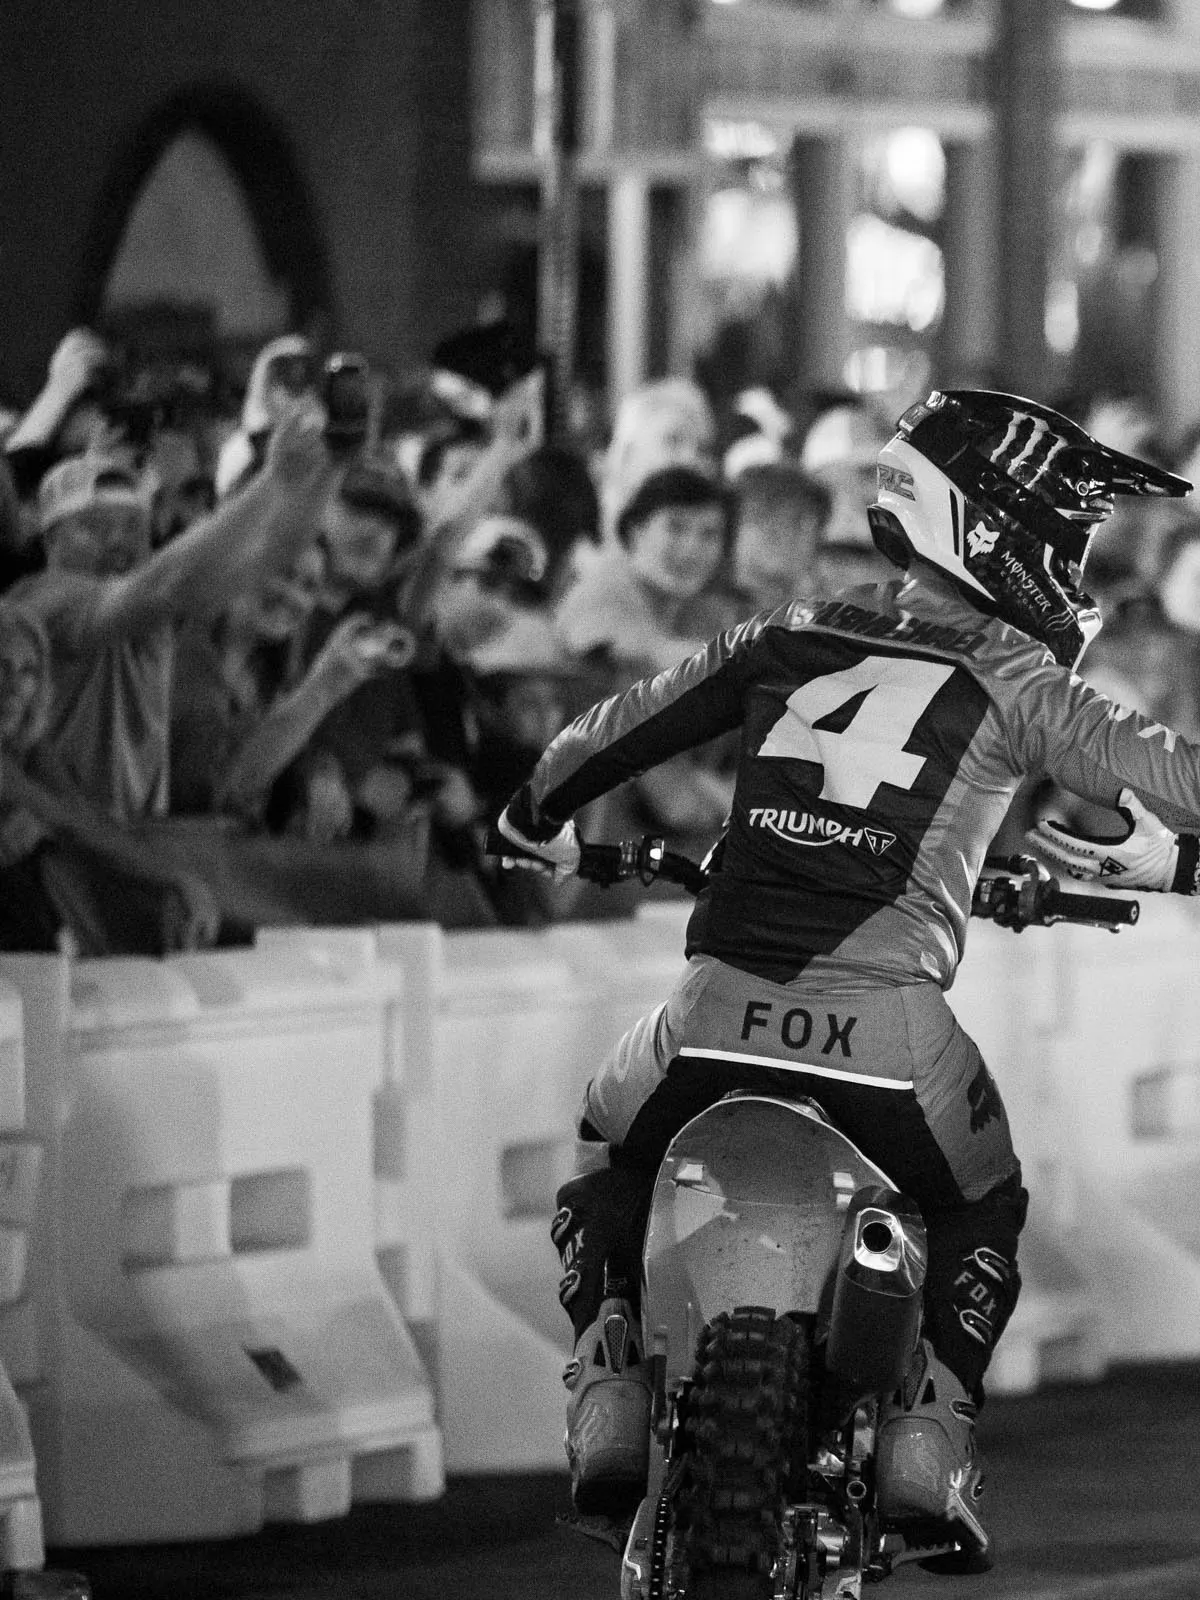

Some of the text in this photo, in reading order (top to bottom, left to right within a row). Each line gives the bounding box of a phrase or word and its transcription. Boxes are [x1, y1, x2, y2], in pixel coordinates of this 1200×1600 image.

[757, 655, 957, 810] 4
[748, 808, 864, 847] TRIUMPH
[740, 1000, 858, 1058] FOX
[953, 1271, 997, 1316] FOX
